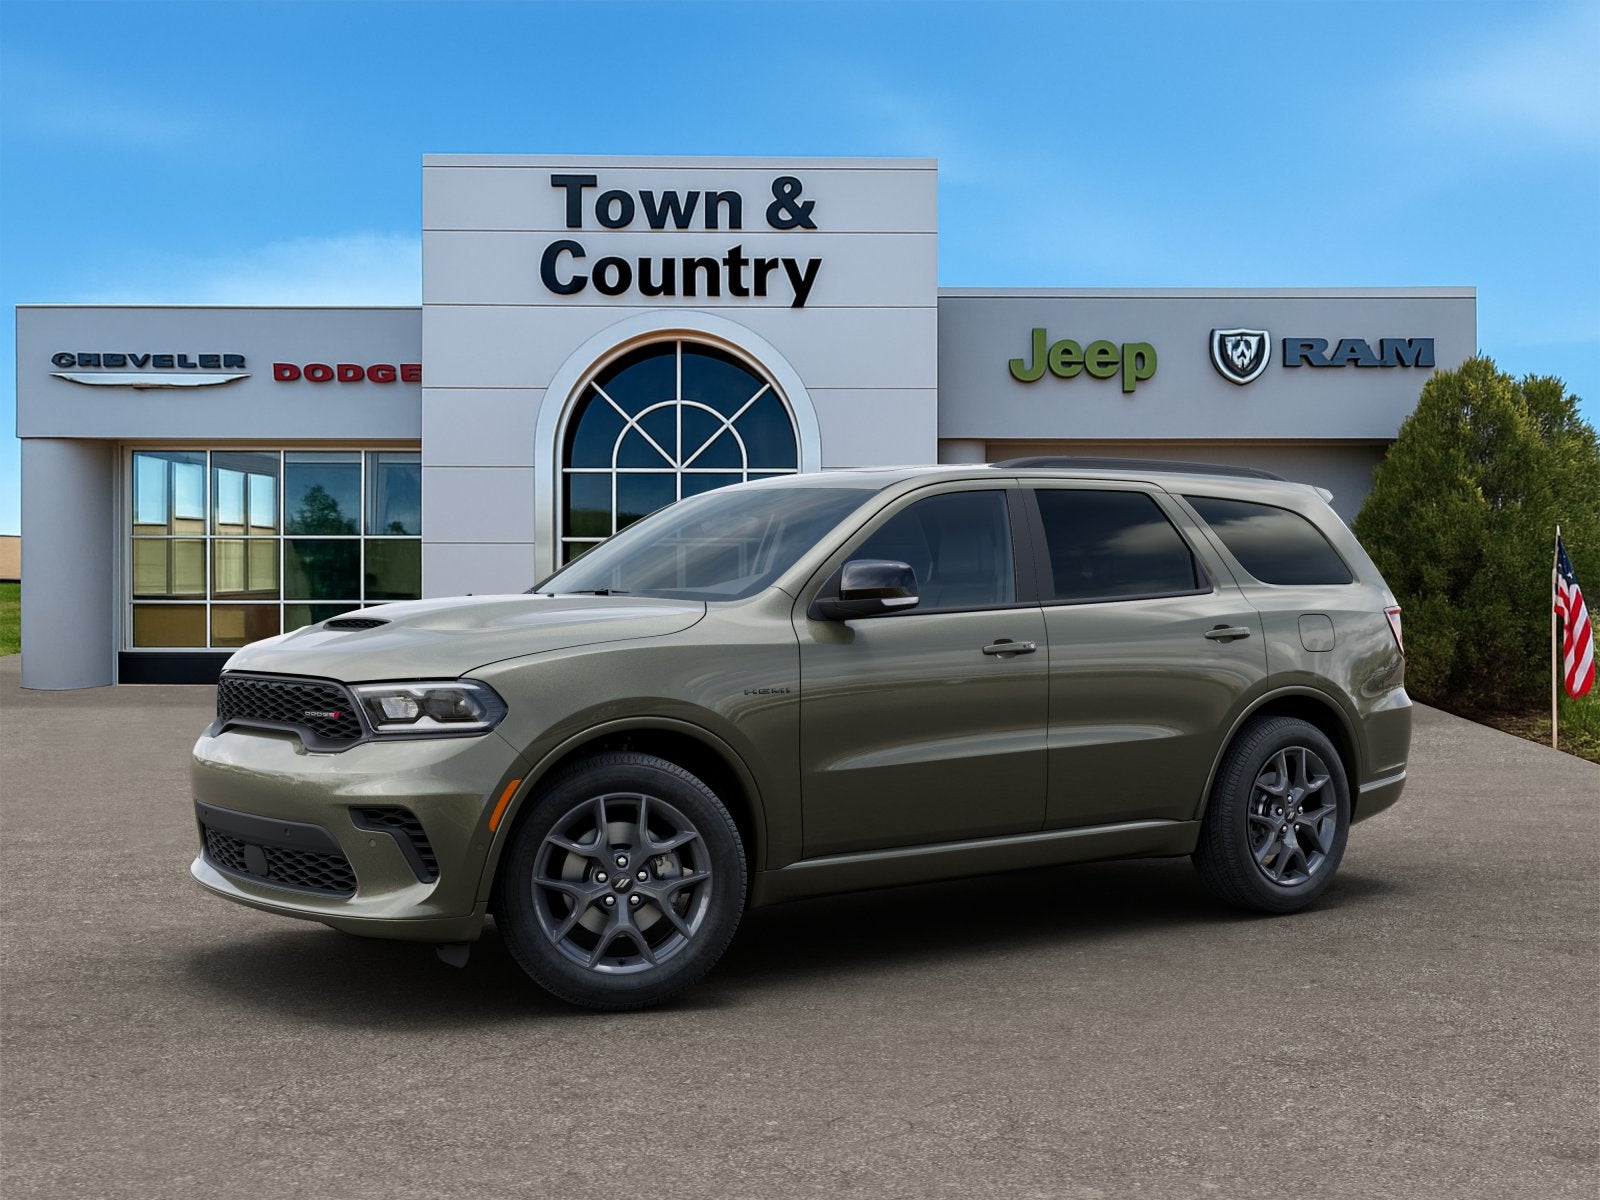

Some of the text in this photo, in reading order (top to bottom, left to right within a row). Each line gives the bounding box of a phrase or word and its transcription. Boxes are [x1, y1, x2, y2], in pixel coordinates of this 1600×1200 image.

[551, 174, 818, 230] Town &
[540, 239, 822, 308] Country
[273, 363, 422, 383] DODGE
[1008, 327, 1158, 393] Jeep
[1282, 337, 1435, 368] RAM
